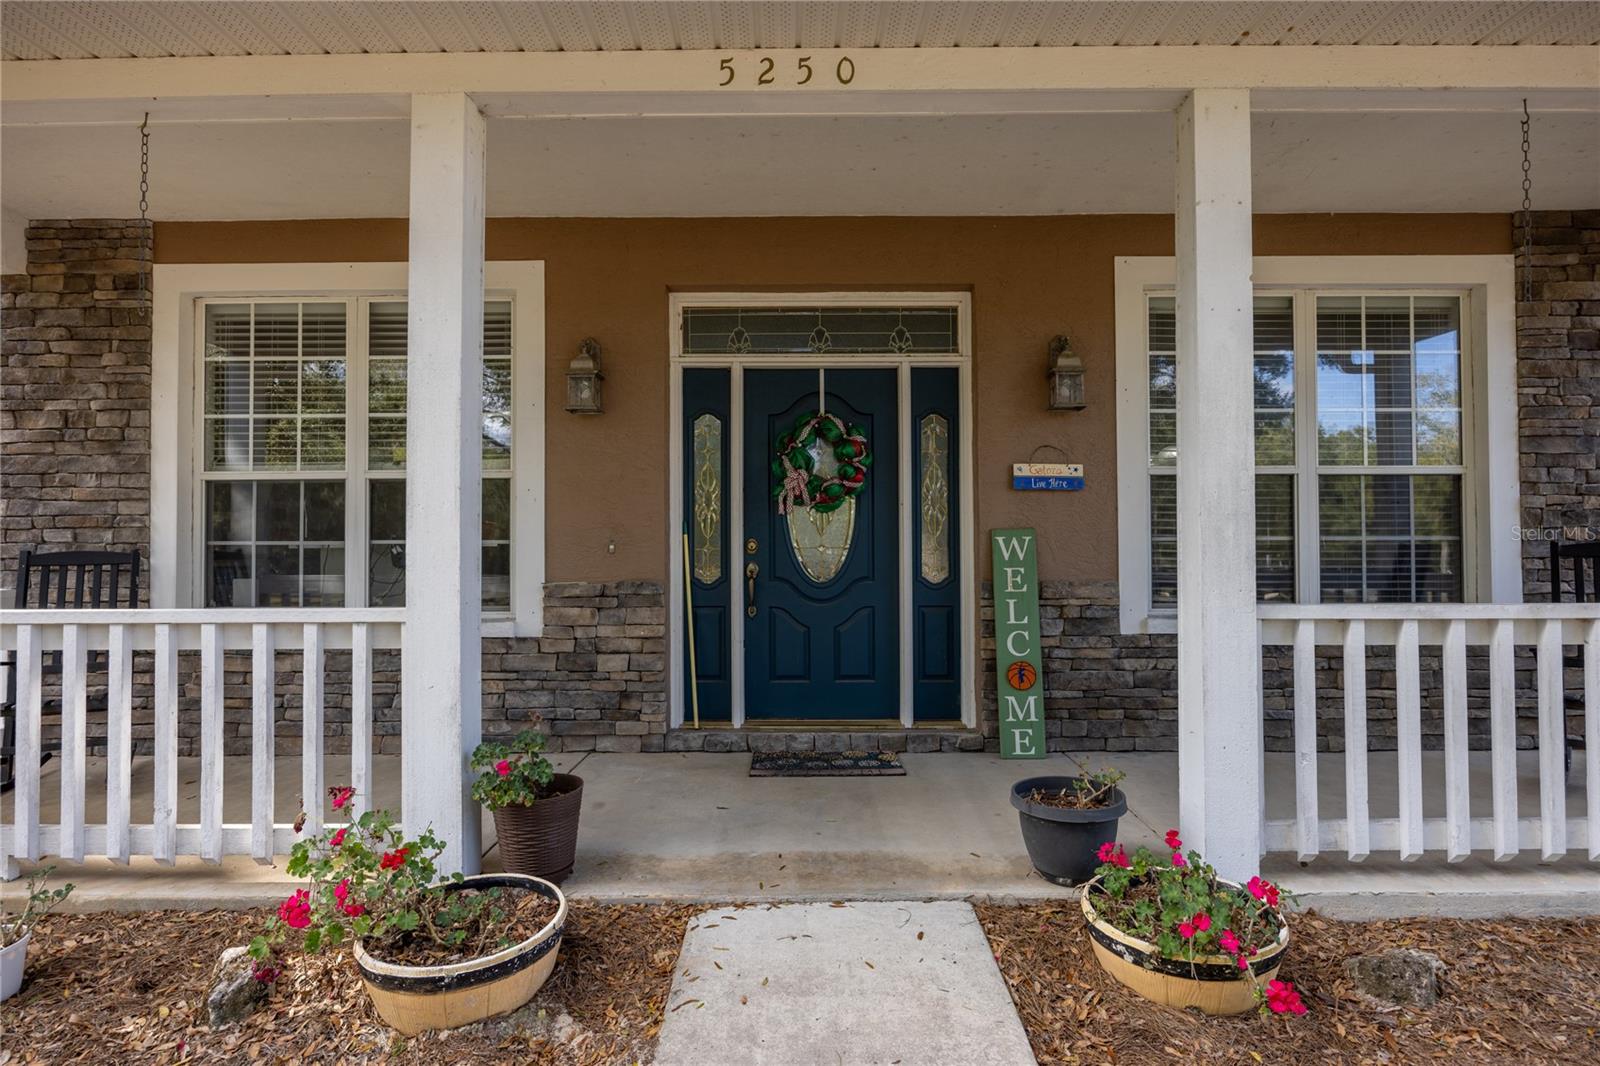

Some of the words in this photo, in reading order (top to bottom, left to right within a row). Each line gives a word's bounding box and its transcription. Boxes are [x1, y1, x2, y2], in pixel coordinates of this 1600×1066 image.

[719, 56, 855, 86] 5250
[1031, 477, 1046, 488] Live
[1048, 477, 1069, 489] Here
